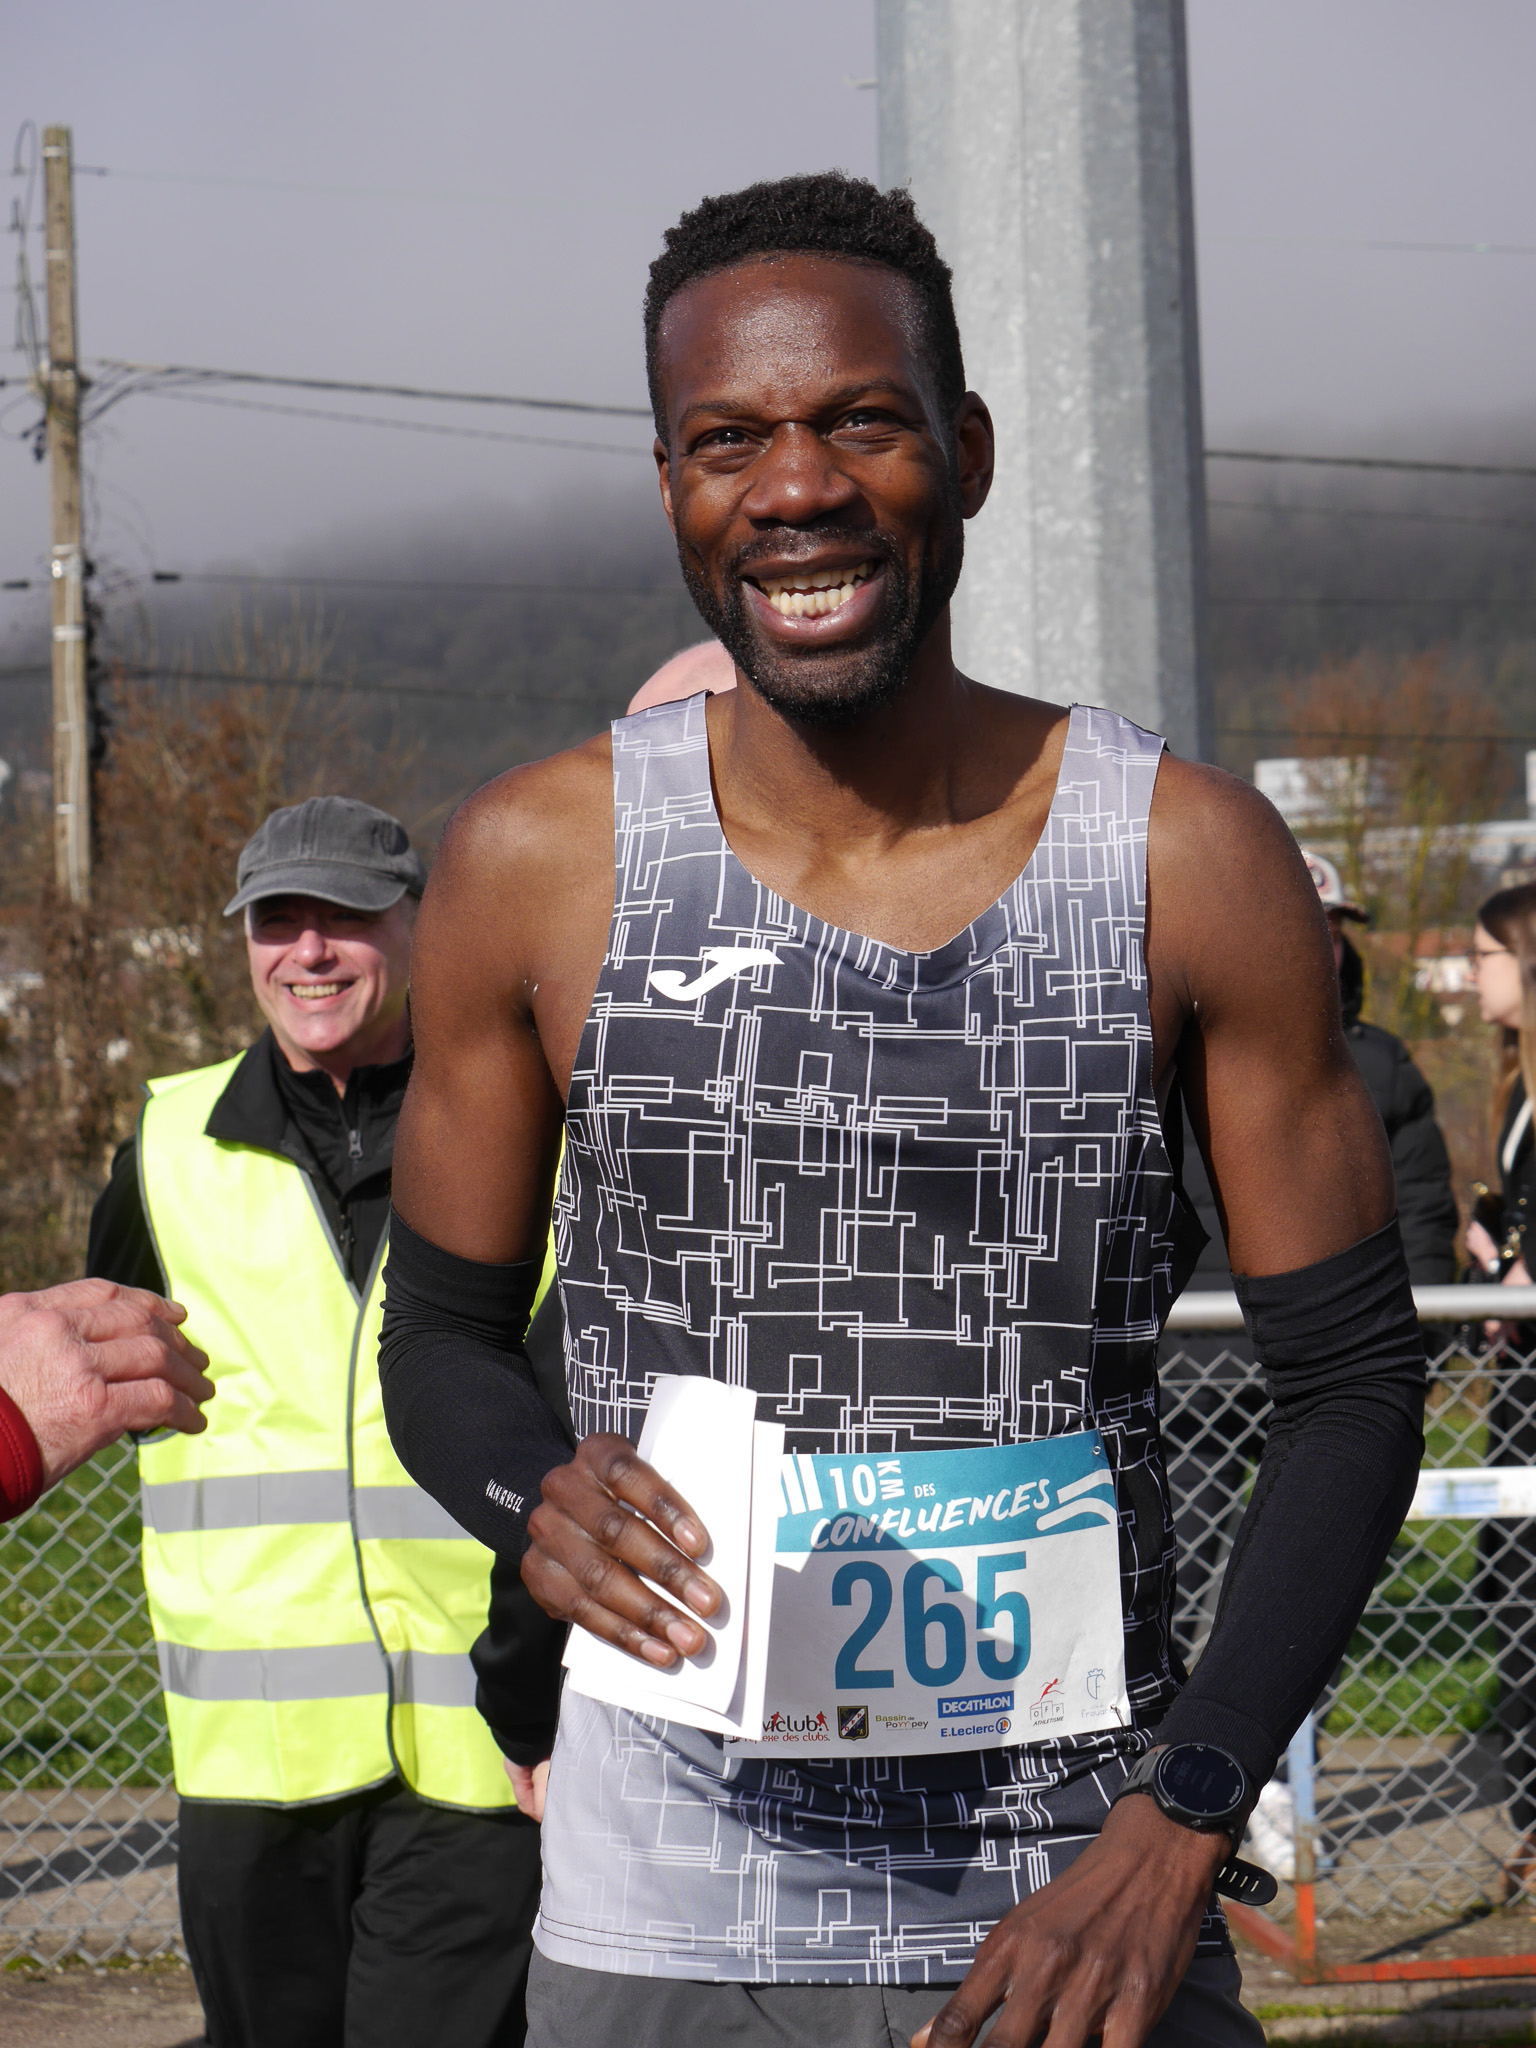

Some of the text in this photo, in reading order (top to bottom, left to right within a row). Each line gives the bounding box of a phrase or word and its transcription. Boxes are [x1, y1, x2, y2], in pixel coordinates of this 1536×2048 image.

[829, 1460, 936, 1509] 10 KM DES
[810, 1478, 1050, 1550] CONFLUENCES
[832, 1551, 1031, 1690] 265
[942, 1696, 1011, 1714] DECATHLON
[875, 1714, 907, 1722] Bassin
[782, 1732, 799, 1742] des
[941, 1723, 994, 1738] E.Leclerc
